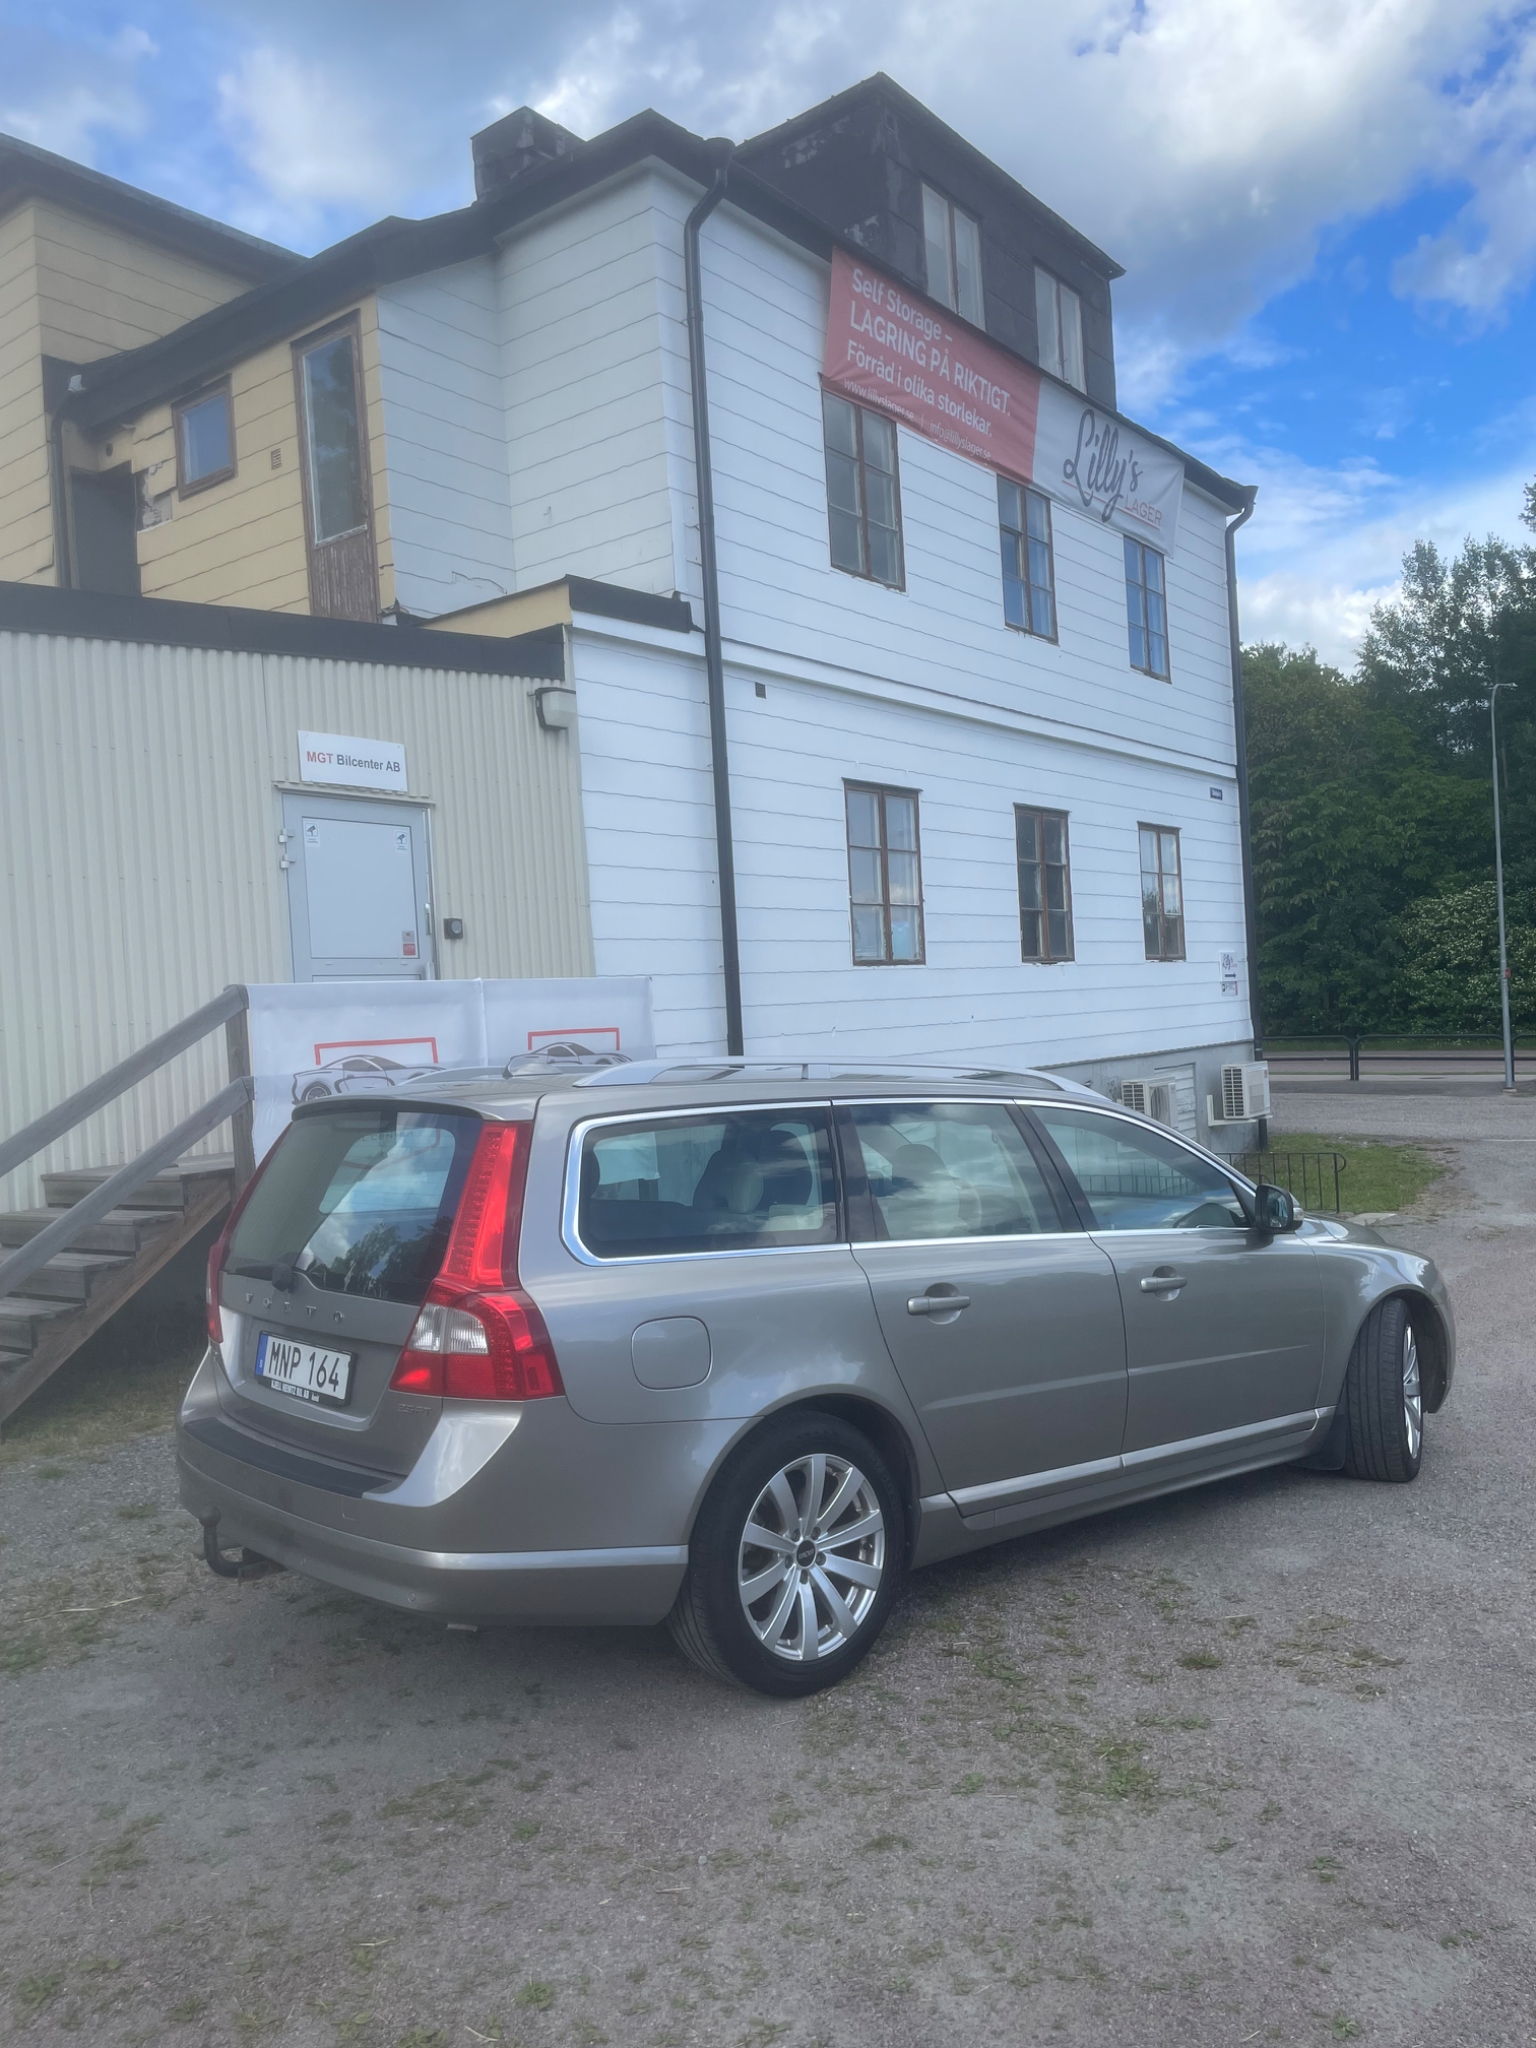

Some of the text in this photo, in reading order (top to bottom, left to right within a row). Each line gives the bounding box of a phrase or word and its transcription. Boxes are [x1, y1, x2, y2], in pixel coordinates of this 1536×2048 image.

[852, 268, 884, 306] Self
[886, 288, 942, 342] Storage
[847, 339, 993, 438] Förråd i olika storlekar.
[850, 300, 1011, 417] LAGRING PÅ RIKTIGT.
[844, 378, 915, 423] www.lillyslager.se
[930, 419, 992, 461] info@lillyslager.se
[1063, 408, 1144, 523] Lilly's
[1123, 493, 1163, 529] LAGER
[306, 750, 401, 773] MGT Bilcenter AB
[245, 1292, 345, 1324] VOLVO
[268, 1341, 302, 1380] MNP
[309, 1351, 340, 1393] 164
